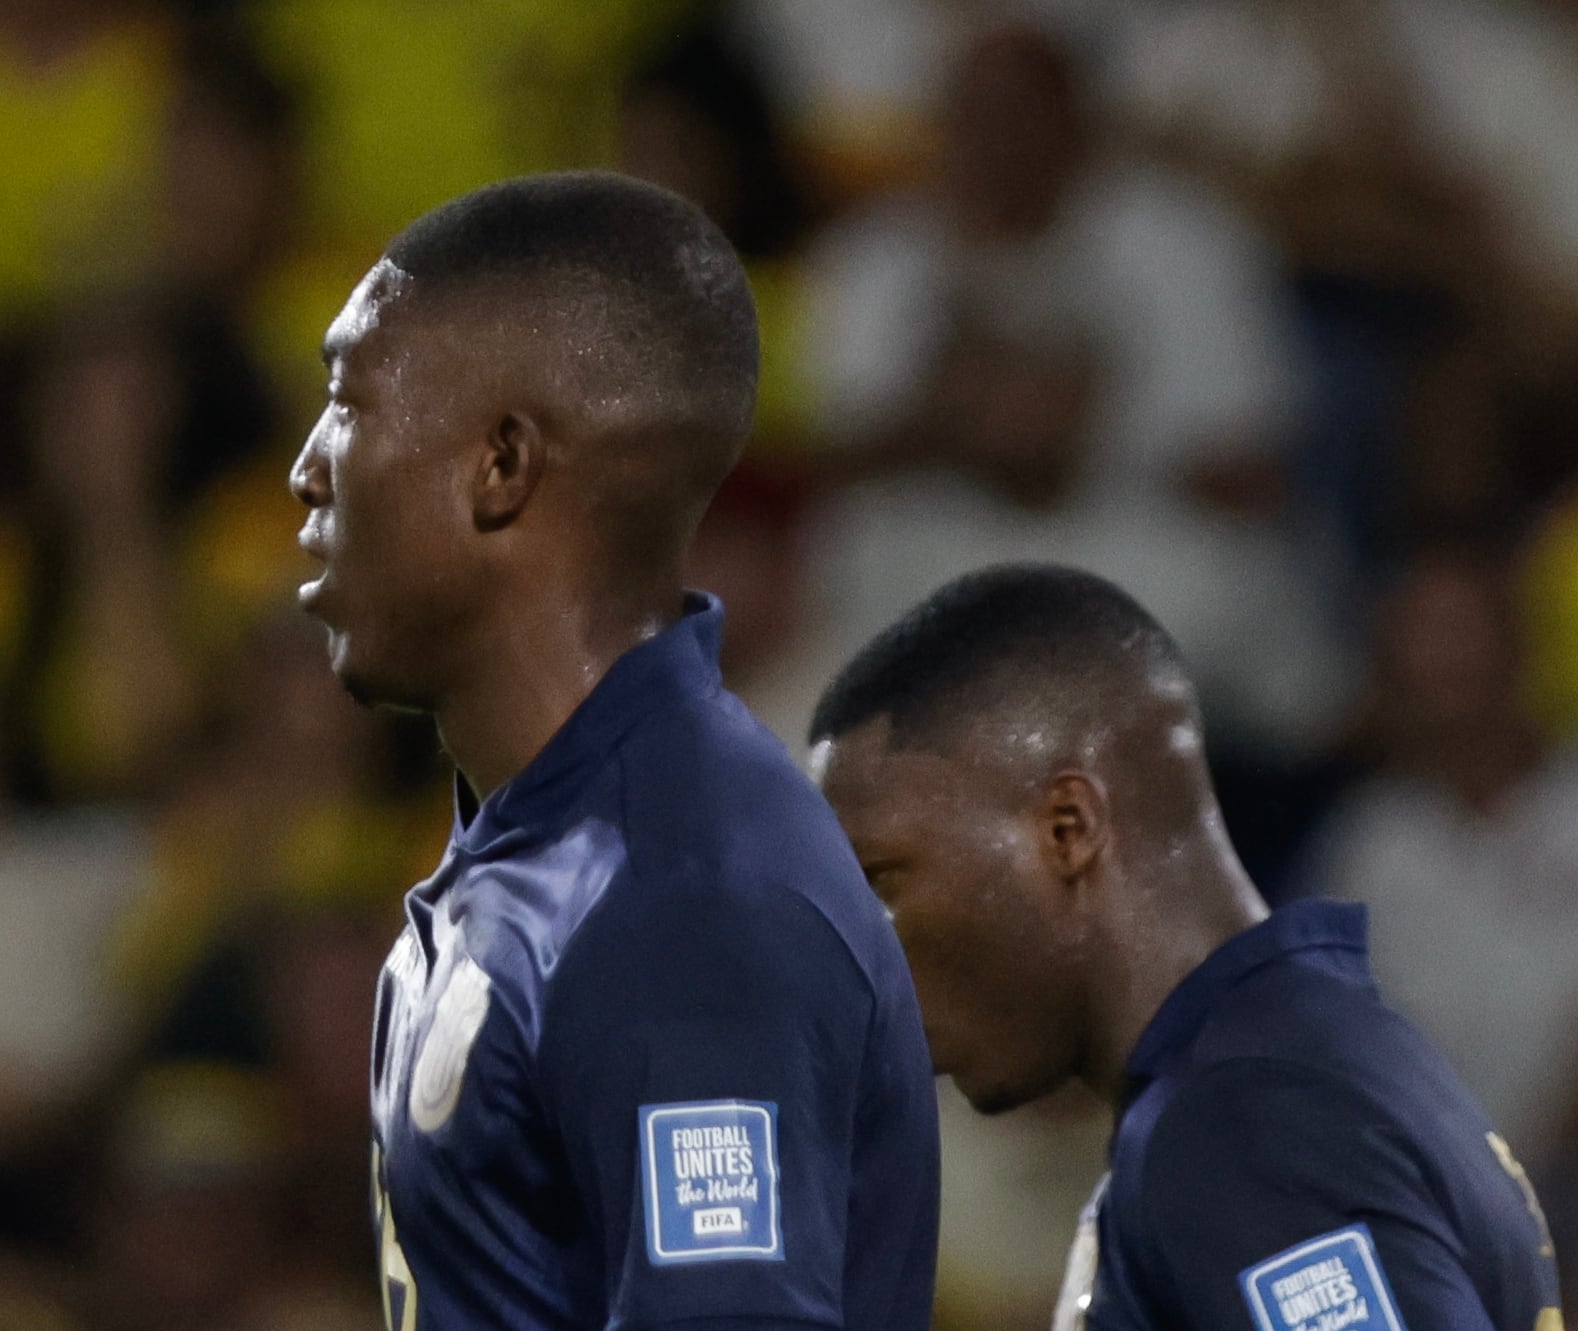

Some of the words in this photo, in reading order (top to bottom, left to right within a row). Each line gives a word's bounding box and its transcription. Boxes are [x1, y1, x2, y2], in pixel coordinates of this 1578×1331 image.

[672, 1126, 752, 1150] FOOTBALL
[674, 1147, 753, 1179] UNITES
[675, 1179, 705, 1206] the
[707, 1177, 758, 1203] World
[700, 1213, 735, 1229] FIFA
[1279, 1273, 1358, 1327] UNITES
